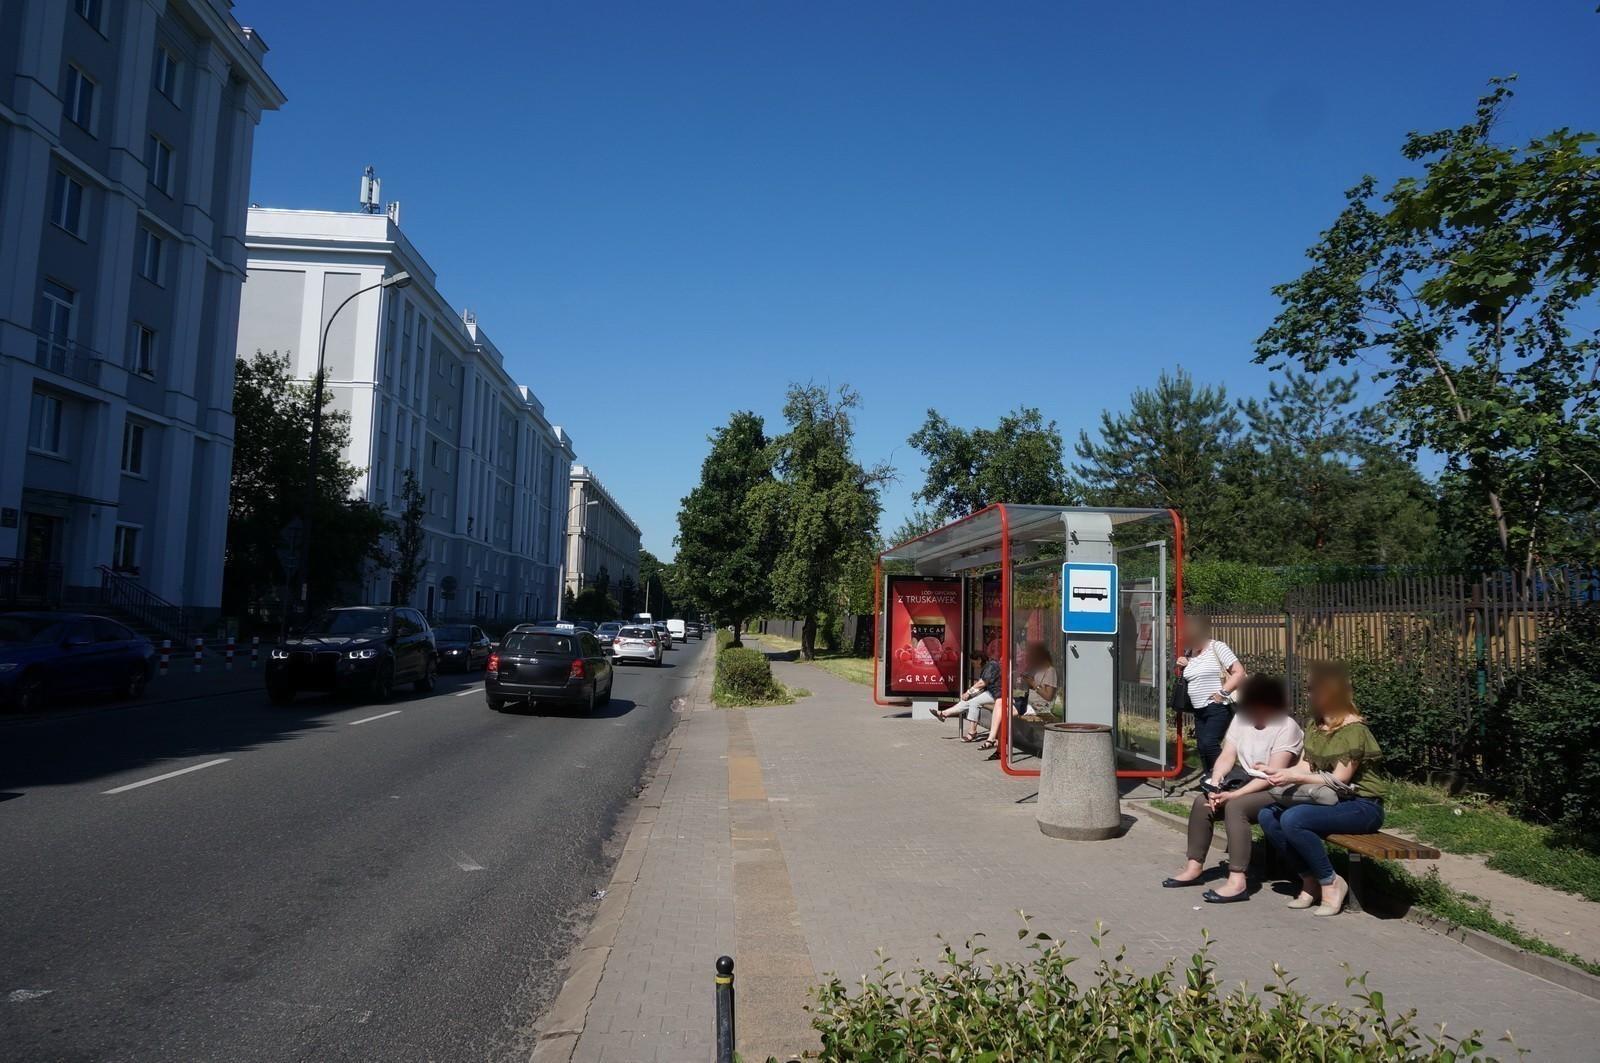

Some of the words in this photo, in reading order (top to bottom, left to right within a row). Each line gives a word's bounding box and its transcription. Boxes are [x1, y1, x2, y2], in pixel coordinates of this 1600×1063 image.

[898, 595, 904, 604] Z
[906, 595, 956, 604] TRUSKAWEK
[899, 674, 954, 683] GRYCAN
